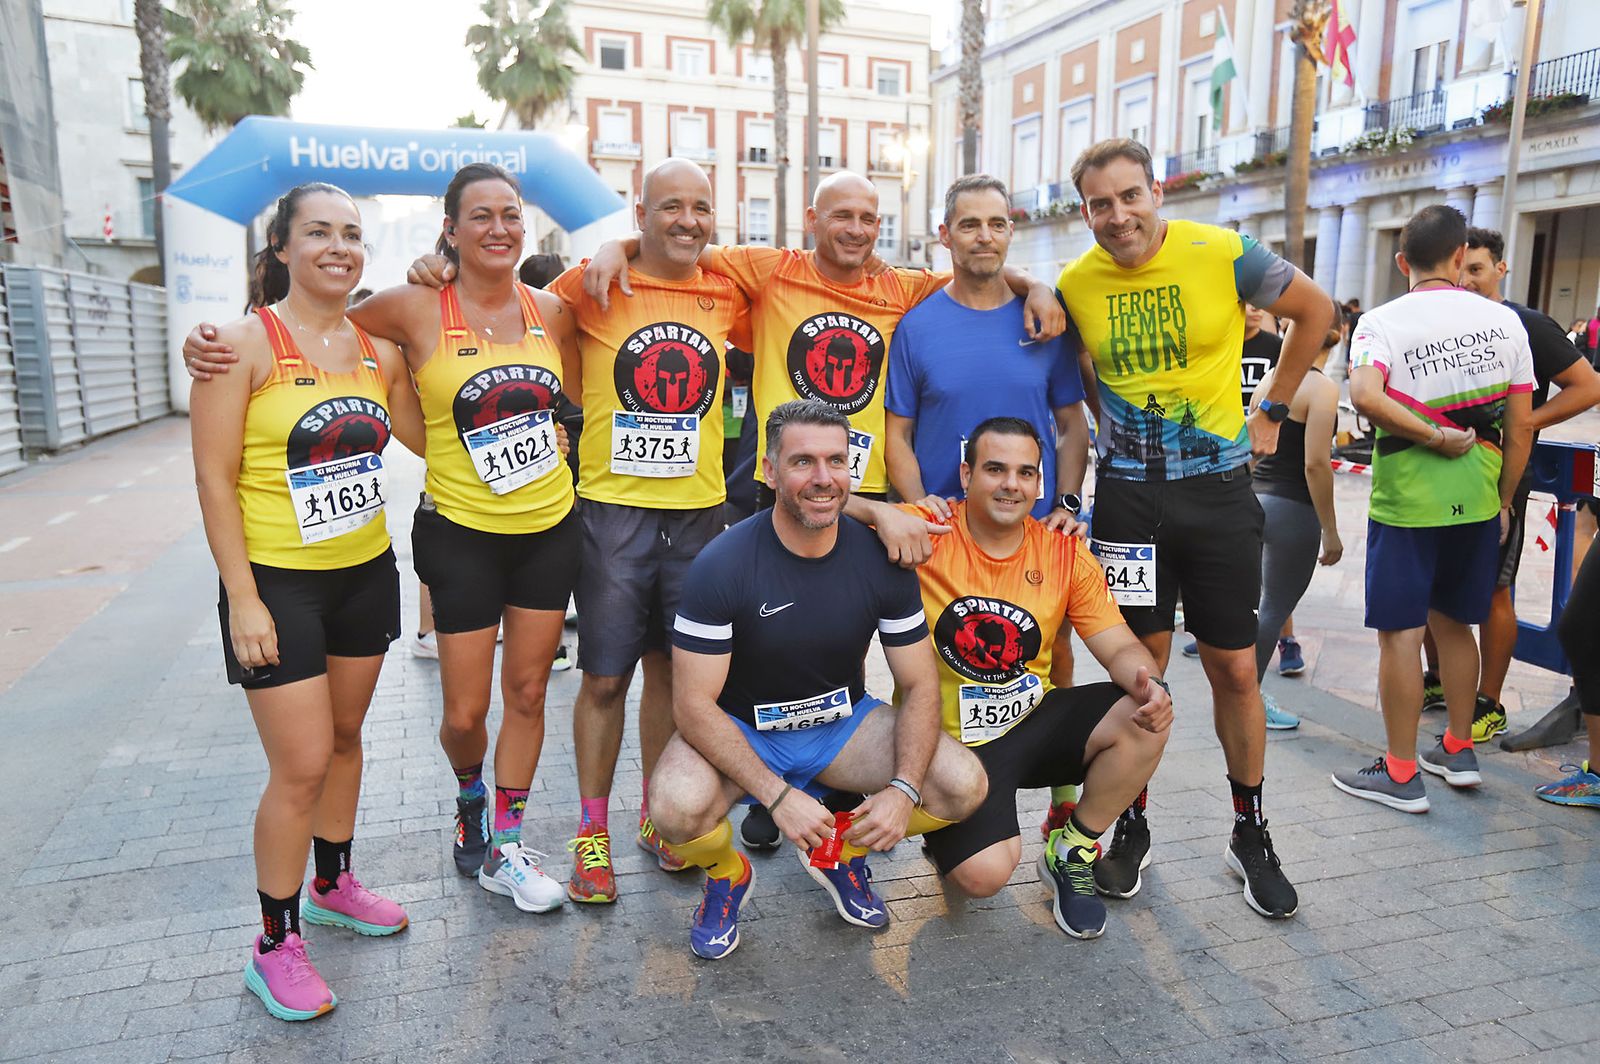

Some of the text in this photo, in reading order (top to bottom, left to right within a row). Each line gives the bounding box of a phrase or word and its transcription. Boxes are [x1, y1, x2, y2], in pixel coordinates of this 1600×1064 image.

[289, 136, 527, 175] Huelva original
[1528, 135, 1580, 152] MCMXLIX
[1346, 154, 1460, 183] AYUNTAMIENTO
[1106, 284, 1181, 320] TERCER
[803, 315, 880, 346] SPARTAN
[1108, 302, 1187, 338] TIEMPO
[627, 325, 711, 355] SPARTAN
[1110, 330, 1188, 377] RUN
[1403, 328, 1509, 364] FUNCIONAL
[1409, 346, 1496, 380] FITNESS
[1463, 360, 1504, 376] HUELVA
[461, 366, 561, 402] SPARTAN
[794, 370, 809, 394] YOU'LL
[838, 403, 851, 411] THE
[852, 391, 869, 408] FINISH
[300, 398, 391, 433] SPARTAN
[498, 416, 530, 433] NOCTURNA
[644, 416, 677, 424] NOCTURNA
[500, 437, 540, 470] 162
[634, 436, 675, 460] 375
[316, 460, 361, 475] XI NOCTURNA
[335, 470, 358, 481] HUELVA
[324, 483, 366, 516] 163
[1102, 545, 1130, 554] NOCTURNA
[1101, 564, 1130, 588] 64
[953, 598, 1035, 632] SPARTAN
[992, 682, 1022, 694] NOCTURNA
[993, 673, 1006, 681] THE
[789, 698, 825, 710] NOCTURNA
[797, 706, 821, 715] HUELVA
[985, 700, 1021, 725] 520
